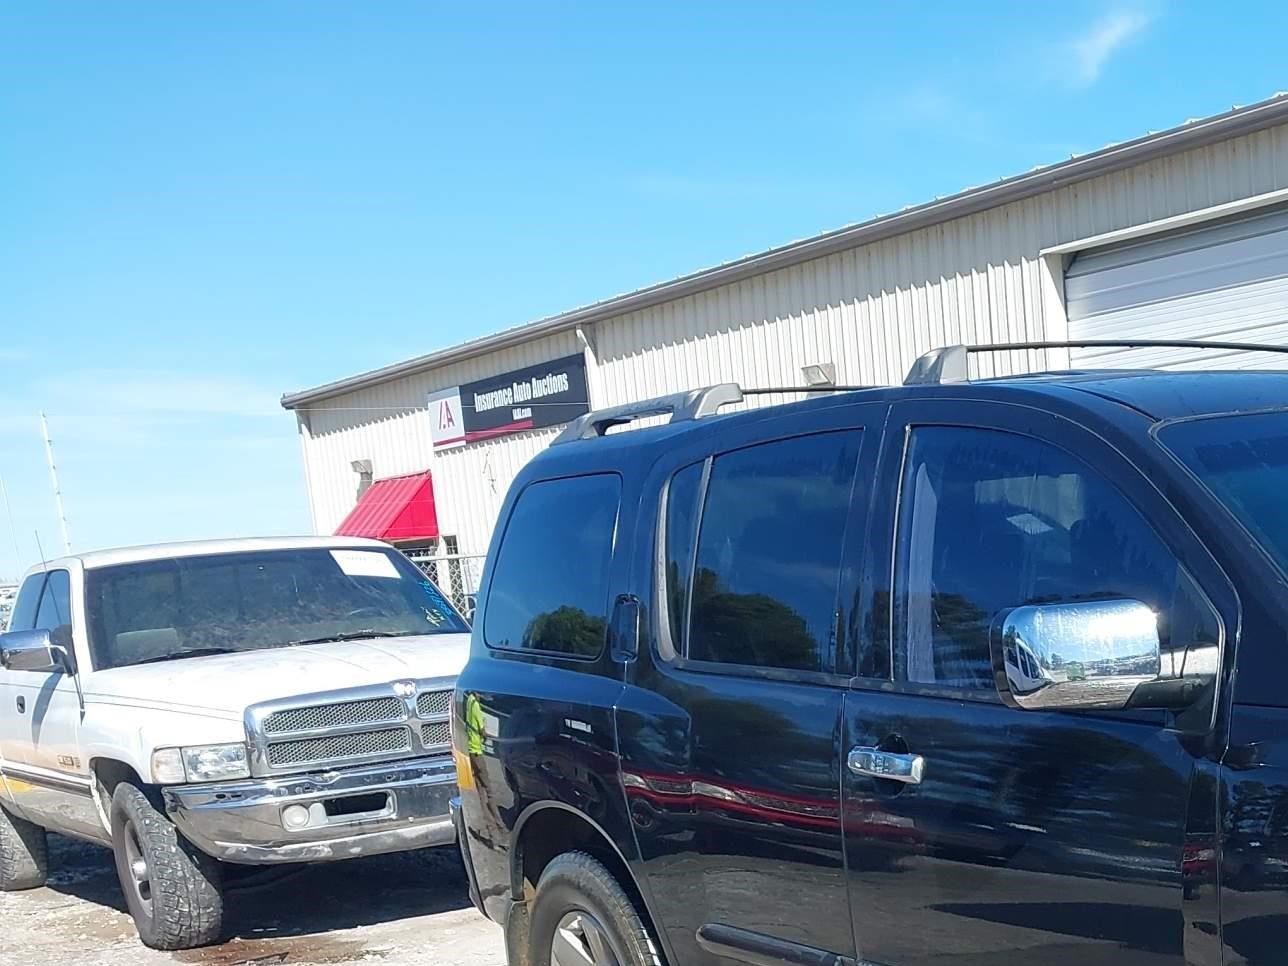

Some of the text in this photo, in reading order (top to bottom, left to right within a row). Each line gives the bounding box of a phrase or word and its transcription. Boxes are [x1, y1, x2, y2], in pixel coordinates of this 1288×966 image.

[474, 373, 569, 413] Insurance Auto Auctions
